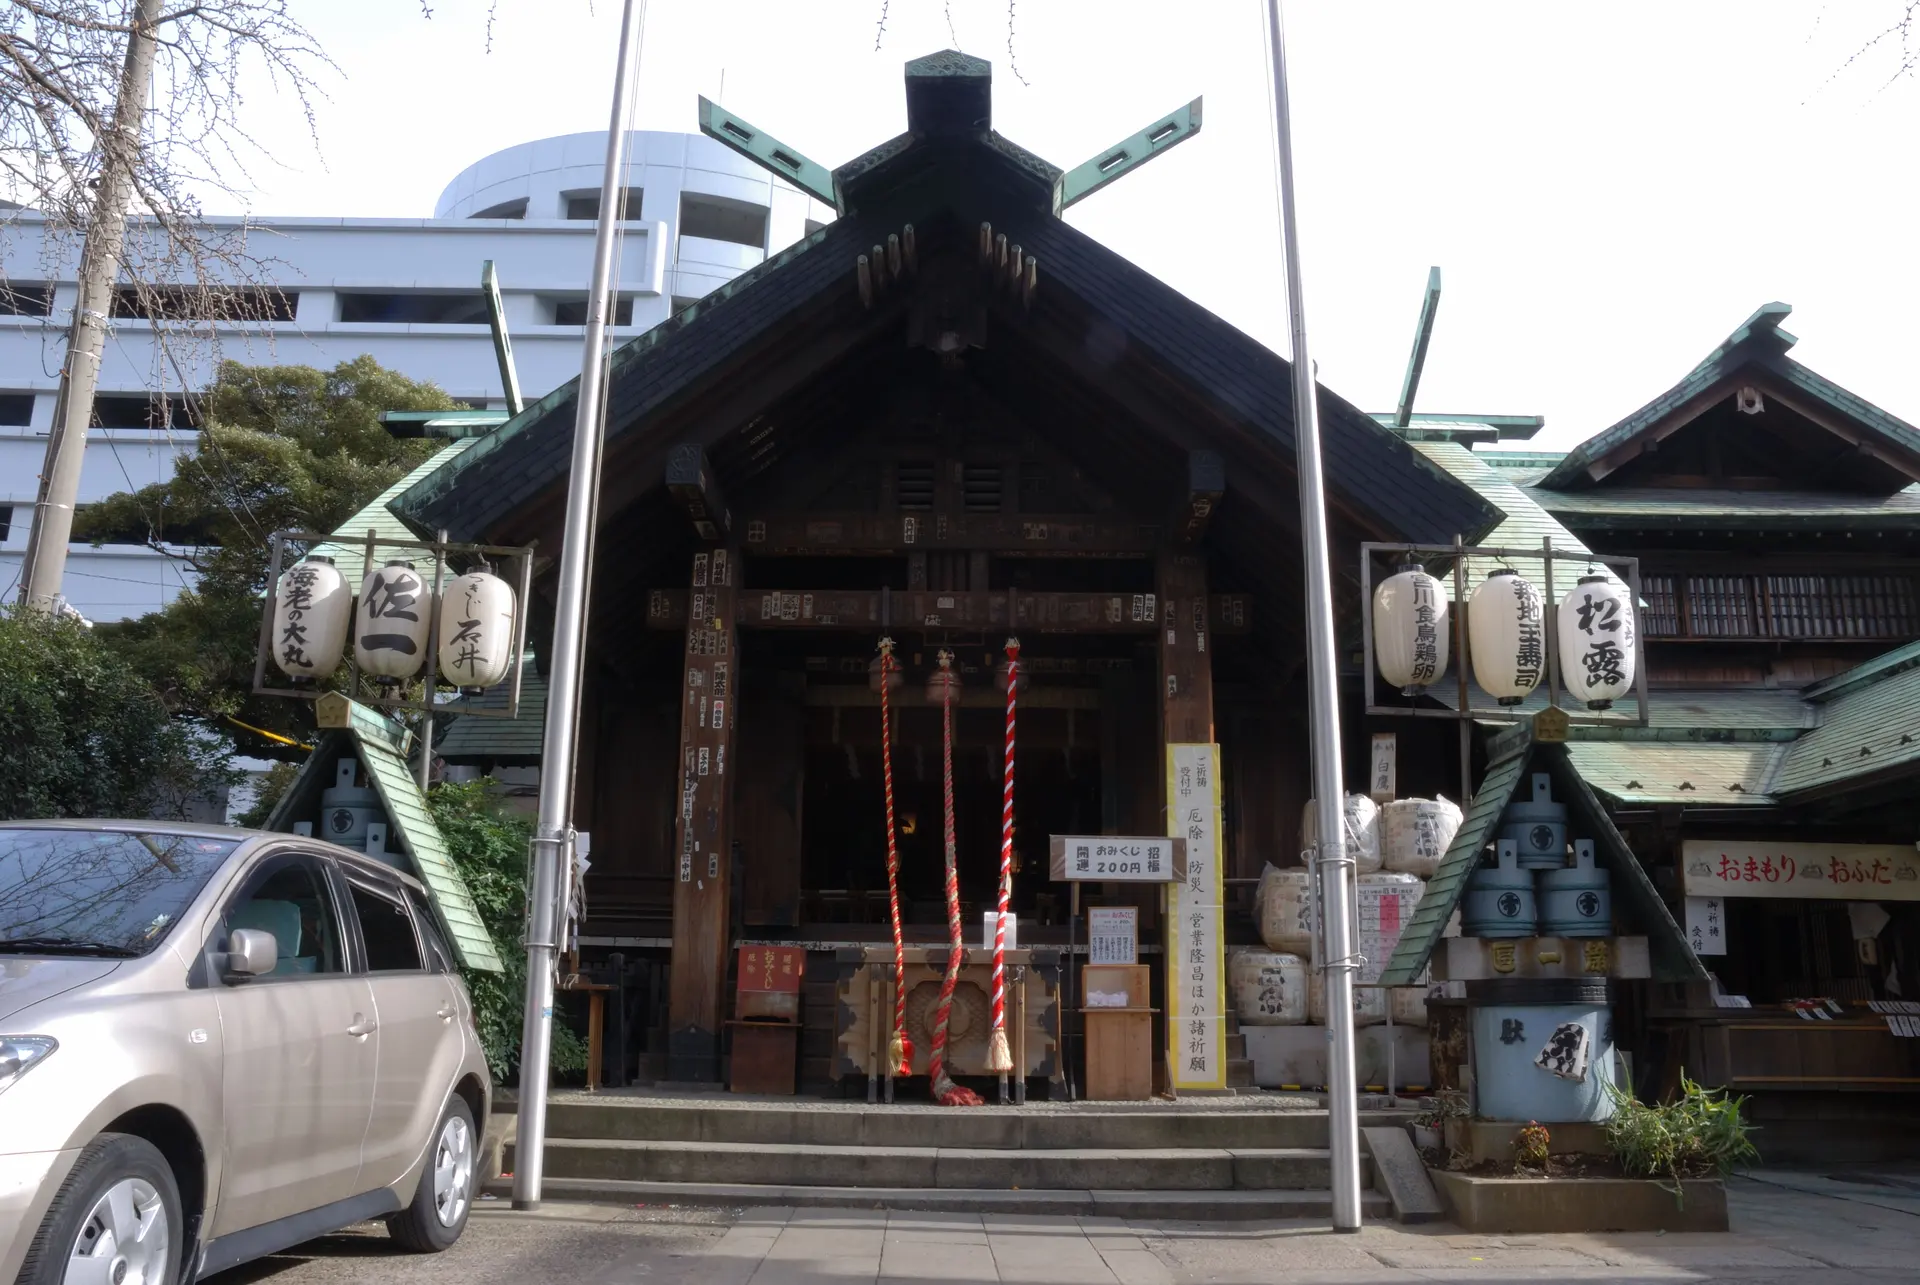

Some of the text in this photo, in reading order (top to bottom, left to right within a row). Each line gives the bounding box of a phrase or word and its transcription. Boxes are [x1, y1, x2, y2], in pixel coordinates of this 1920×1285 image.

[280, 567, 319, 668] 海老の大丸
[360, 573, 419, 655] 佐一
[1410, 575, 1437, 680] 宮川食鳥鶏卵
[1180, 767, 1192, 797] 受付中
[1375, 759, 1390, 791] 白鷹
[1076, 846, 1089, 872] 開運
[1096, 845, 1140, 856] おみくじ
[1147, 846, 1160, 873] 招福
[1716, 854, 1796, 883] おまもり
[1828, 856, 1892, 885] おふだ
[1692, 926, 1703, 951] 受付
[764, 949, 775, 989] おみくじ
